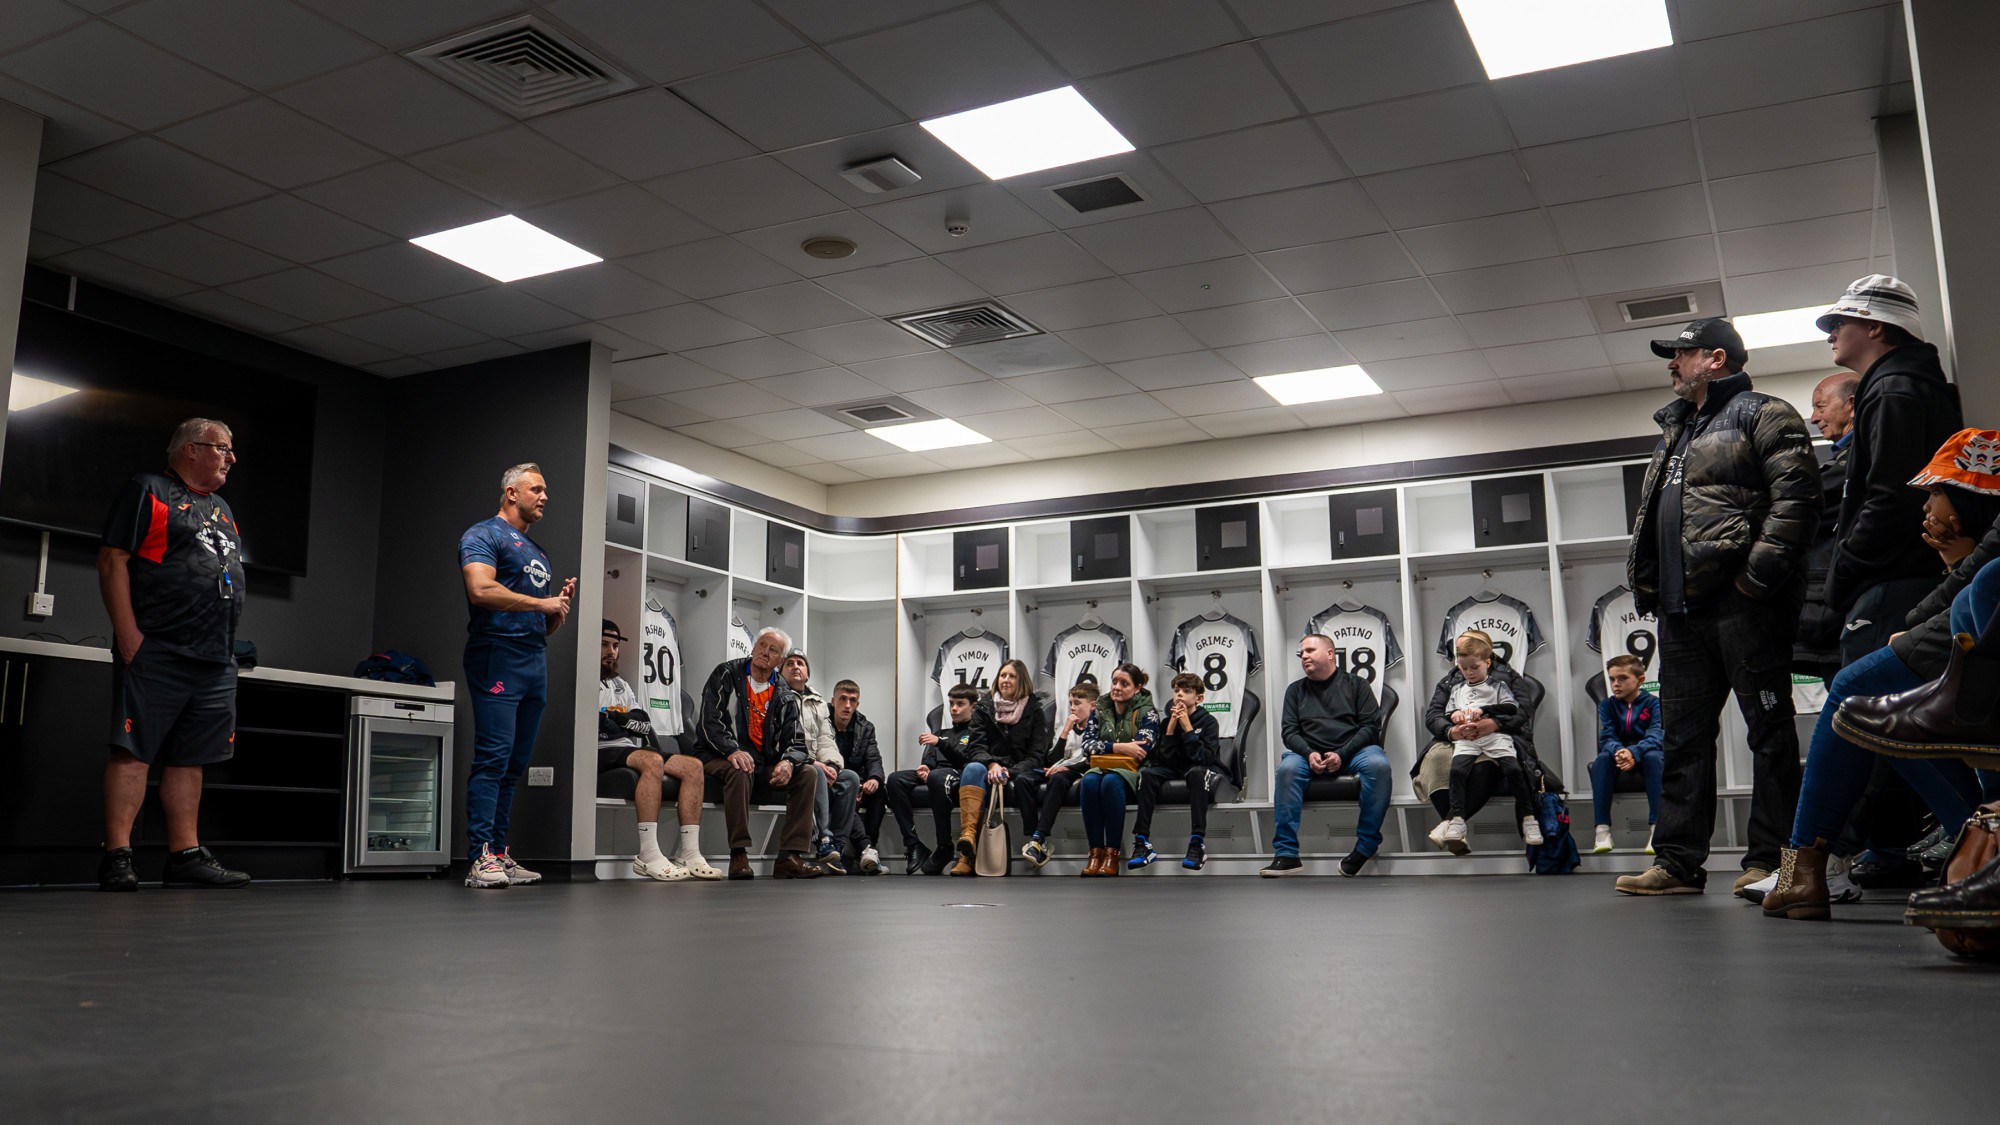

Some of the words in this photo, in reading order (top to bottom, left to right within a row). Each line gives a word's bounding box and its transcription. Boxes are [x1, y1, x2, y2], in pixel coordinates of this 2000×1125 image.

[523, 565, 552, 582] owens
[1621, 612, 1657, 624] YAES
[645, 625, 667, 639] ASHBY
[1333, 626, 1373, 640] PATINO
[1067, 643, 1110, 659] DARLING
[1195, 635, 1235, 651] GRIMES
[1626, 629, 1657, 672] 9
[643, 642, 675, 686] 30
[957, 650, 990, 663] TYMON
[1075, 660, 1098, 685] 6
[1203, 652, 1228, 691] 8
[1335, 646, 1377, 685] 18
[954, 666, 990, 690] 14
